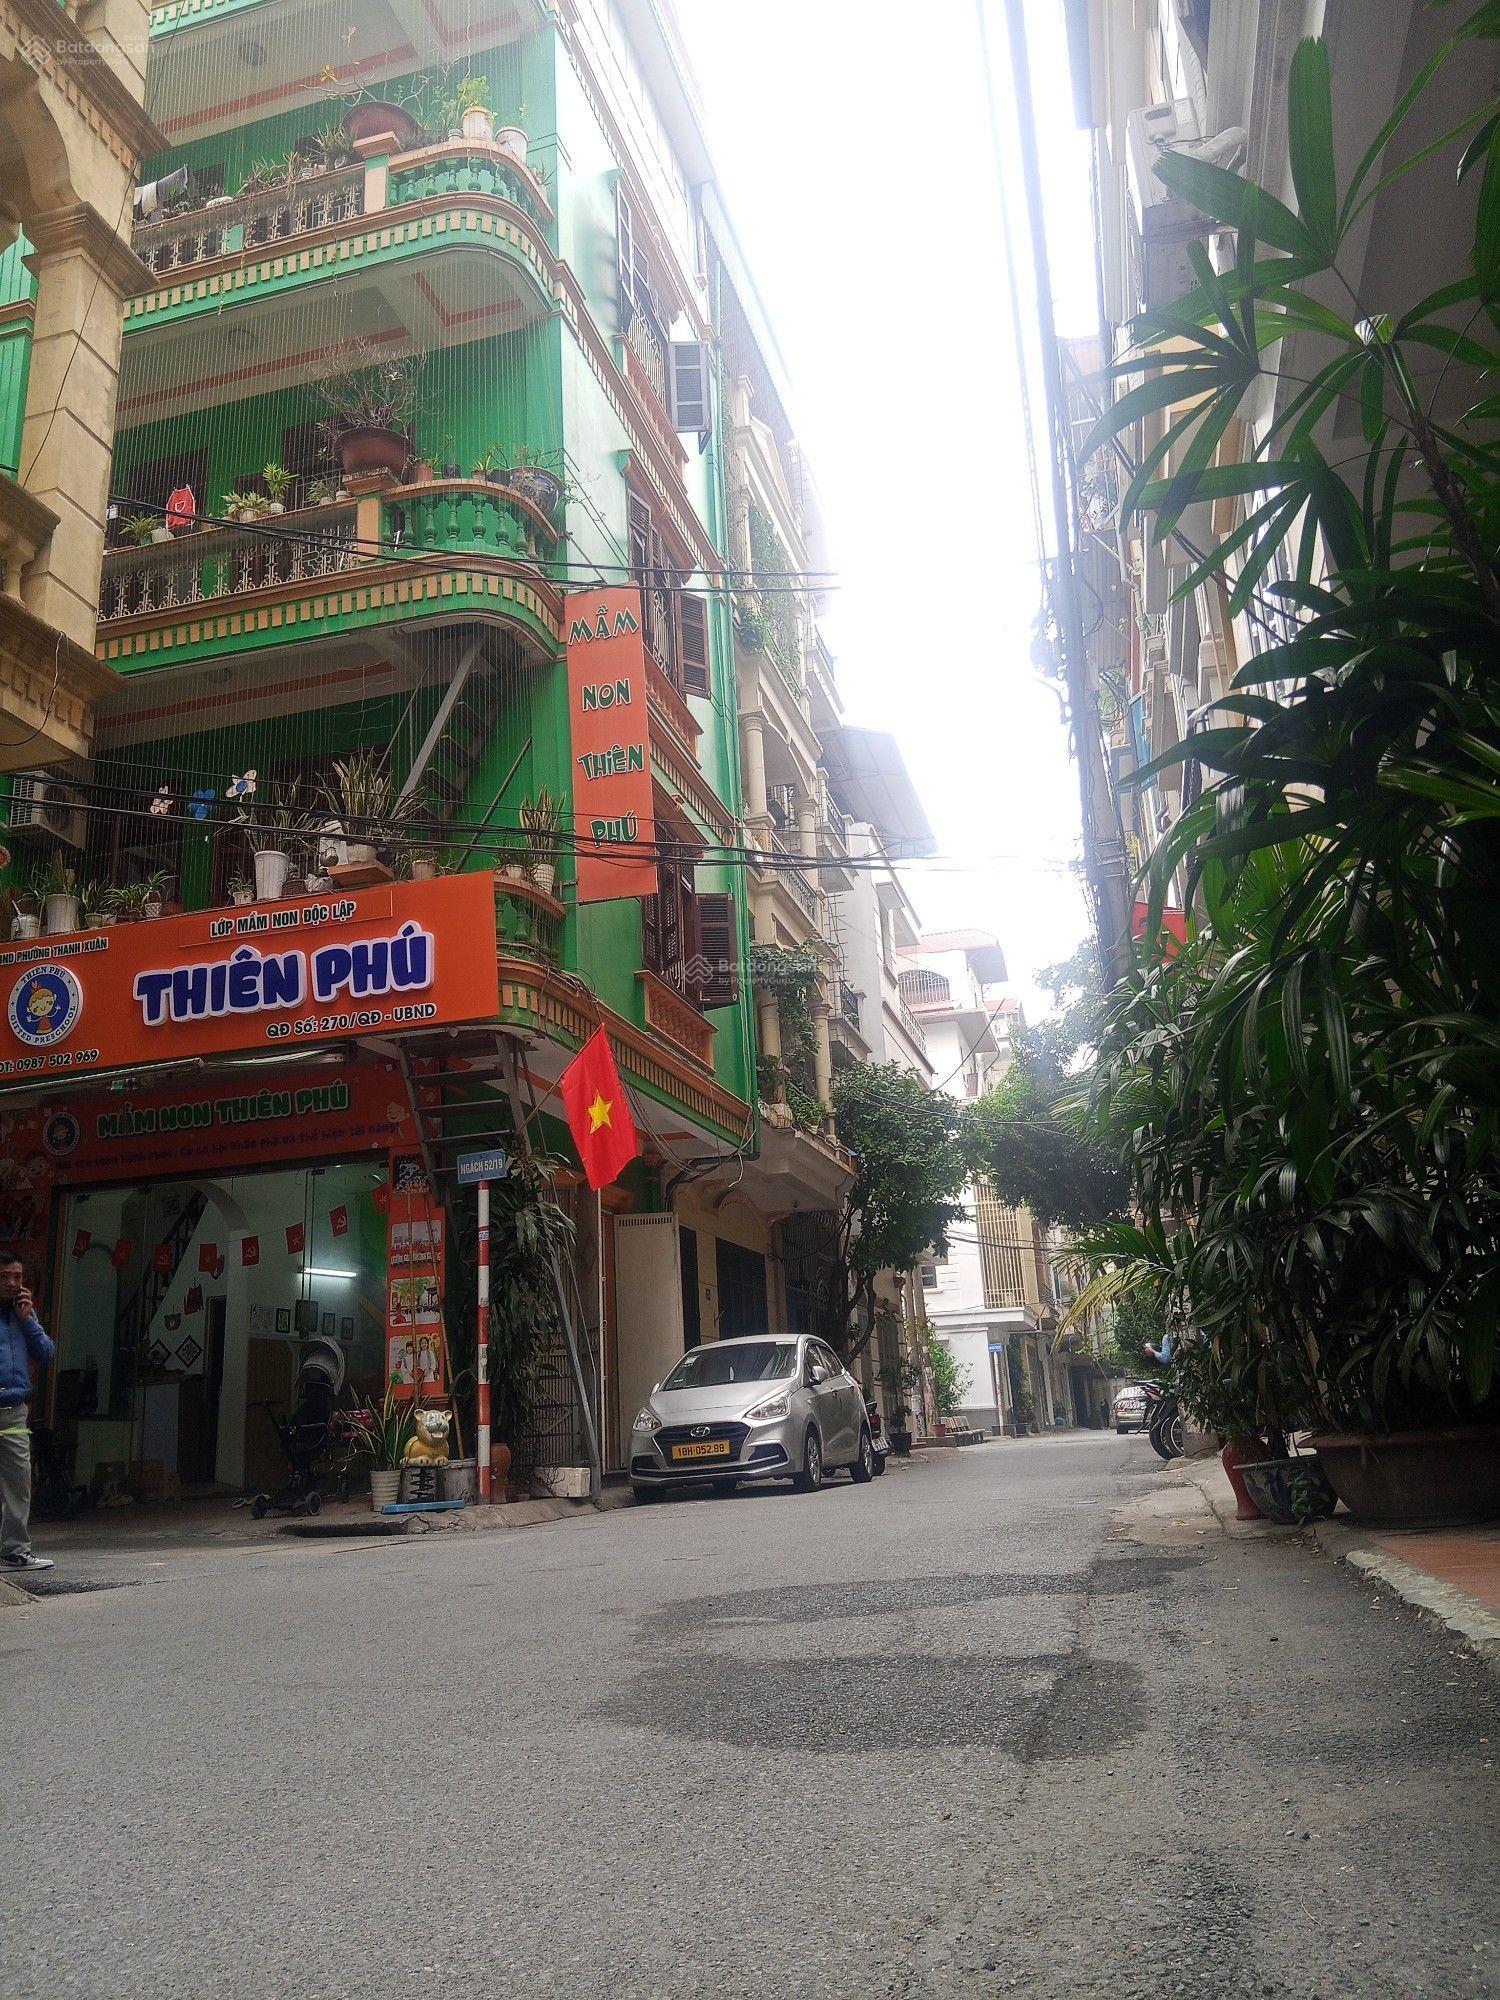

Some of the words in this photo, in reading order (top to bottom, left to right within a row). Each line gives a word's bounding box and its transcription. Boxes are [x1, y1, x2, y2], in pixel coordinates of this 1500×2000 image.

[568, 604, 639, 646] MẦM
[582, 678, 632, 711] NON
[590, 810, 639, 847] PHÚ
[211, 917, 234, 937] LỚP
[236, 911, 269, 934] MẦM
[272, 910, 299, 929] NON
[302, 904, 329, 925] ĐỘC
[332, 900, 356, 921] LẬP
[52, 942, 81, 957] THANH
[83, 937, 109, 952] XUÂN
[135, 945, 305, 1025] THIÊN
[311, 921, 434, 1001] PHÚ
[34, 1005, 76, 1043] PRESCHOOL
[266, 1023, 290, 1038] QĐ
[394, 1003, 437, 1021] UBND
[16, 1056, 46, 1071] 0987
[48, 1052, 72, 1067] 502
[75, 1048, 99, 1064] 969
[159, 1101, 211, 1132] NON
[214, 1088, 291, 1124] THIÊN
[296, 1078, 348, 1114] PHÚ
[460, 1161, 483, 1175] NGÁCH
[484, 1158, 503, 1171] 52/19
